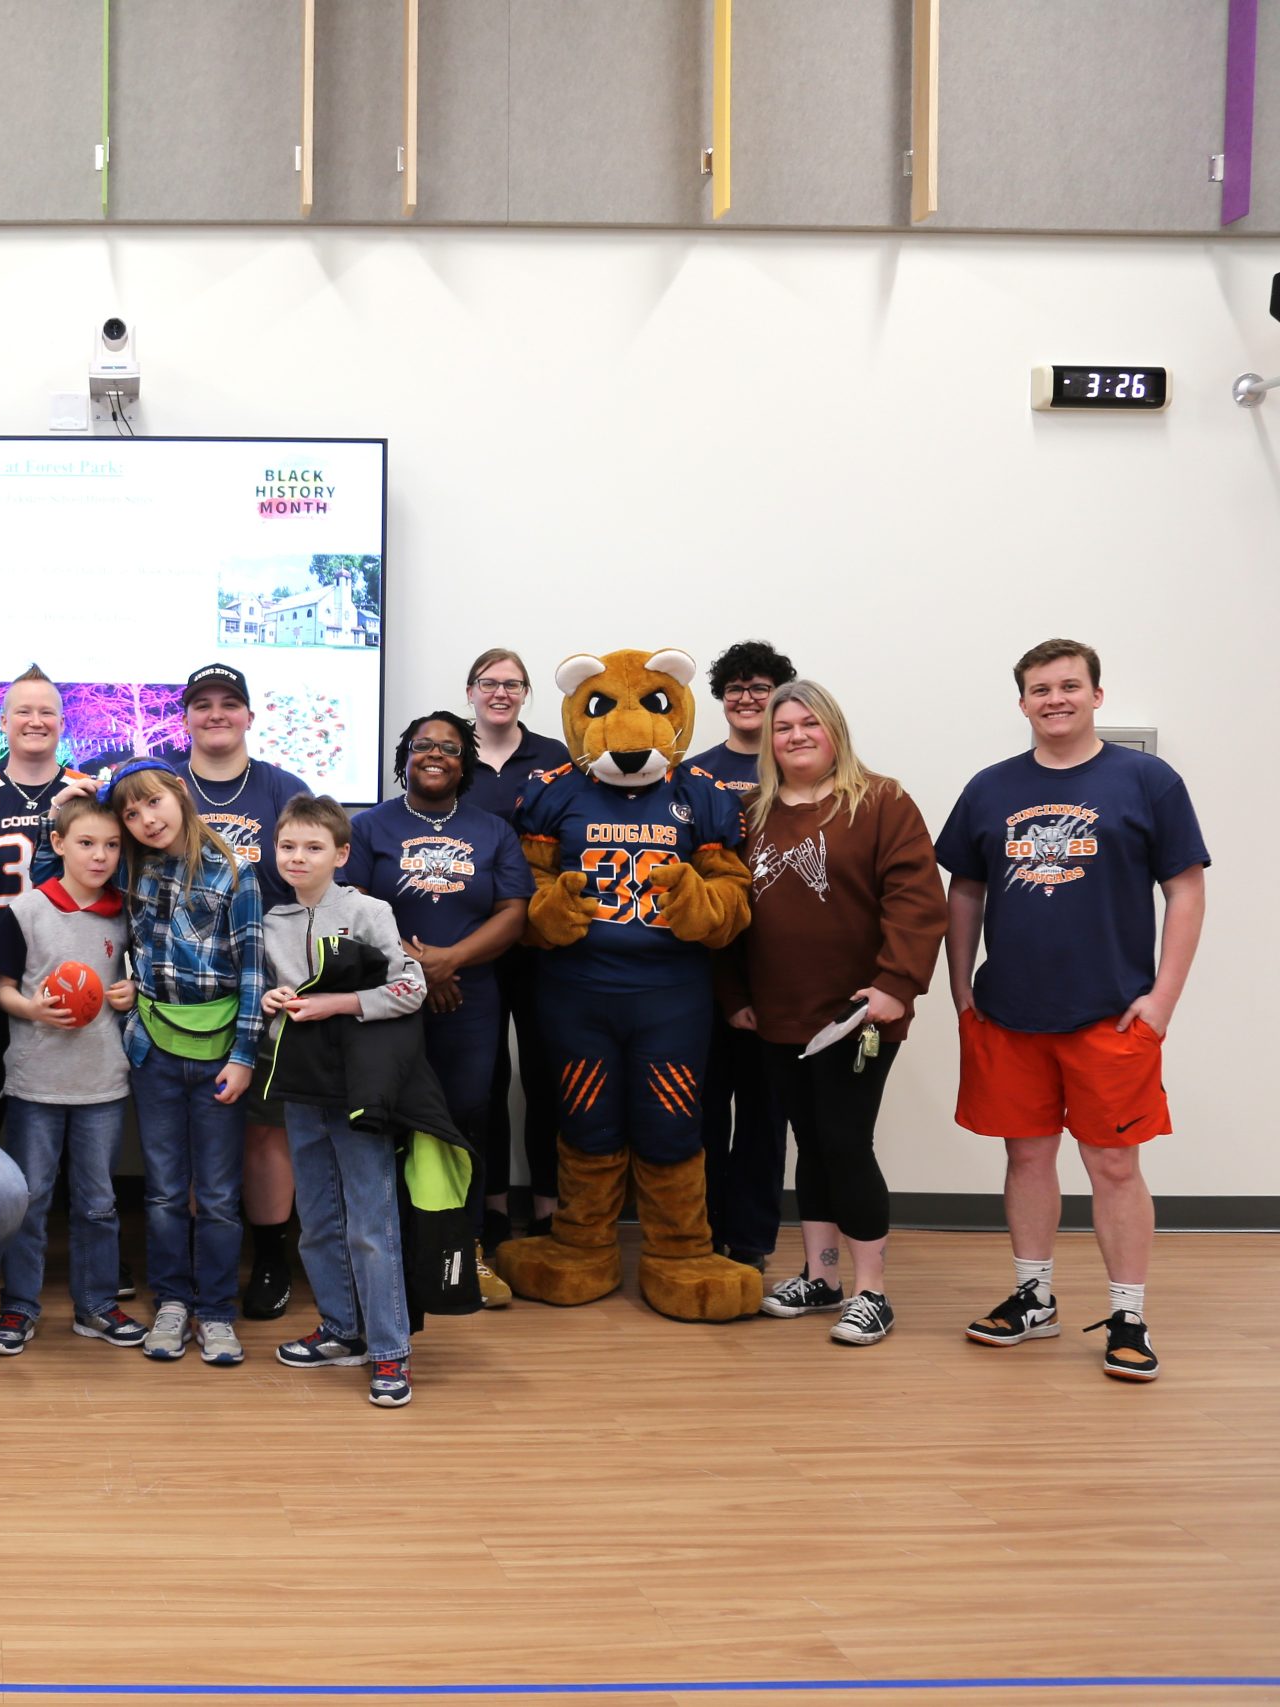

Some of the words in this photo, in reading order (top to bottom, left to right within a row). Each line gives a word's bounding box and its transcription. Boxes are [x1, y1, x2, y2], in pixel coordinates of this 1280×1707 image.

[1085, 373, 1146, 399] 3:26
[25, 459, 75, 474] Forest
[265, 469, 324, 482] BLACK
[255, 485, 336, 498] HISTORY
[260, 501, 328, 514] MONTH
[1006, 804, 1100, 827] CINCINNATI
[586, 823, 678, 846] COUGARS
[1016, 866, 1086, 885] COUGARS
[409, 877, 466, 893] COUGARS
